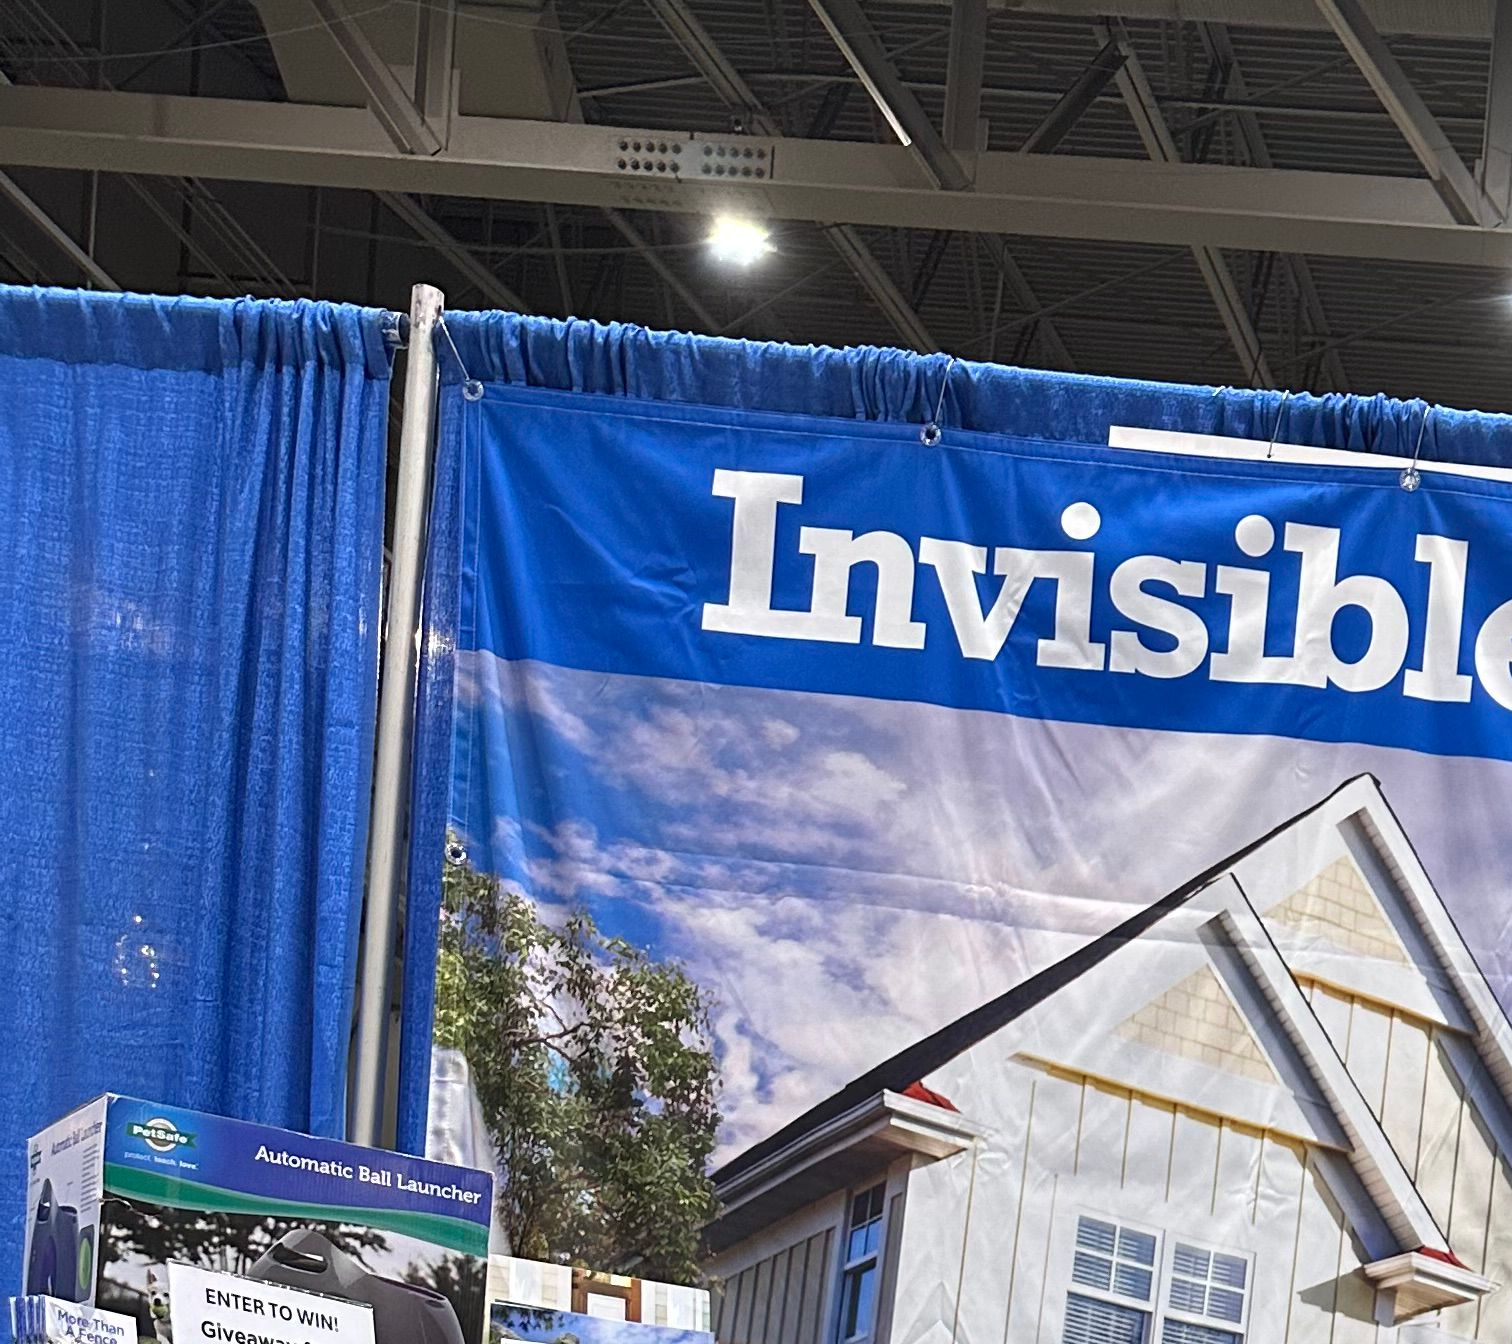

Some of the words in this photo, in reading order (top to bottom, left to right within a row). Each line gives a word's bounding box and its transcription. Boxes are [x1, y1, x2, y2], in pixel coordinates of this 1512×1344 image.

[133, 1125, 188, 1144] PetSafe
[255, 1145, 353, 1179] Automatic
[358, 1165, 392, 1188] Ball
[397, 1173, 482, 1204] Launcher
[205, 1287, 265, 1316] ENTER
[268, 1302, 292, 1321] TO
[296, 1308, 339, 1332] WIN!
[57, 1310, 89, 1328] More
[93, 1318, 125, 1337] Than
[65, 1326, 75, 1337] A
